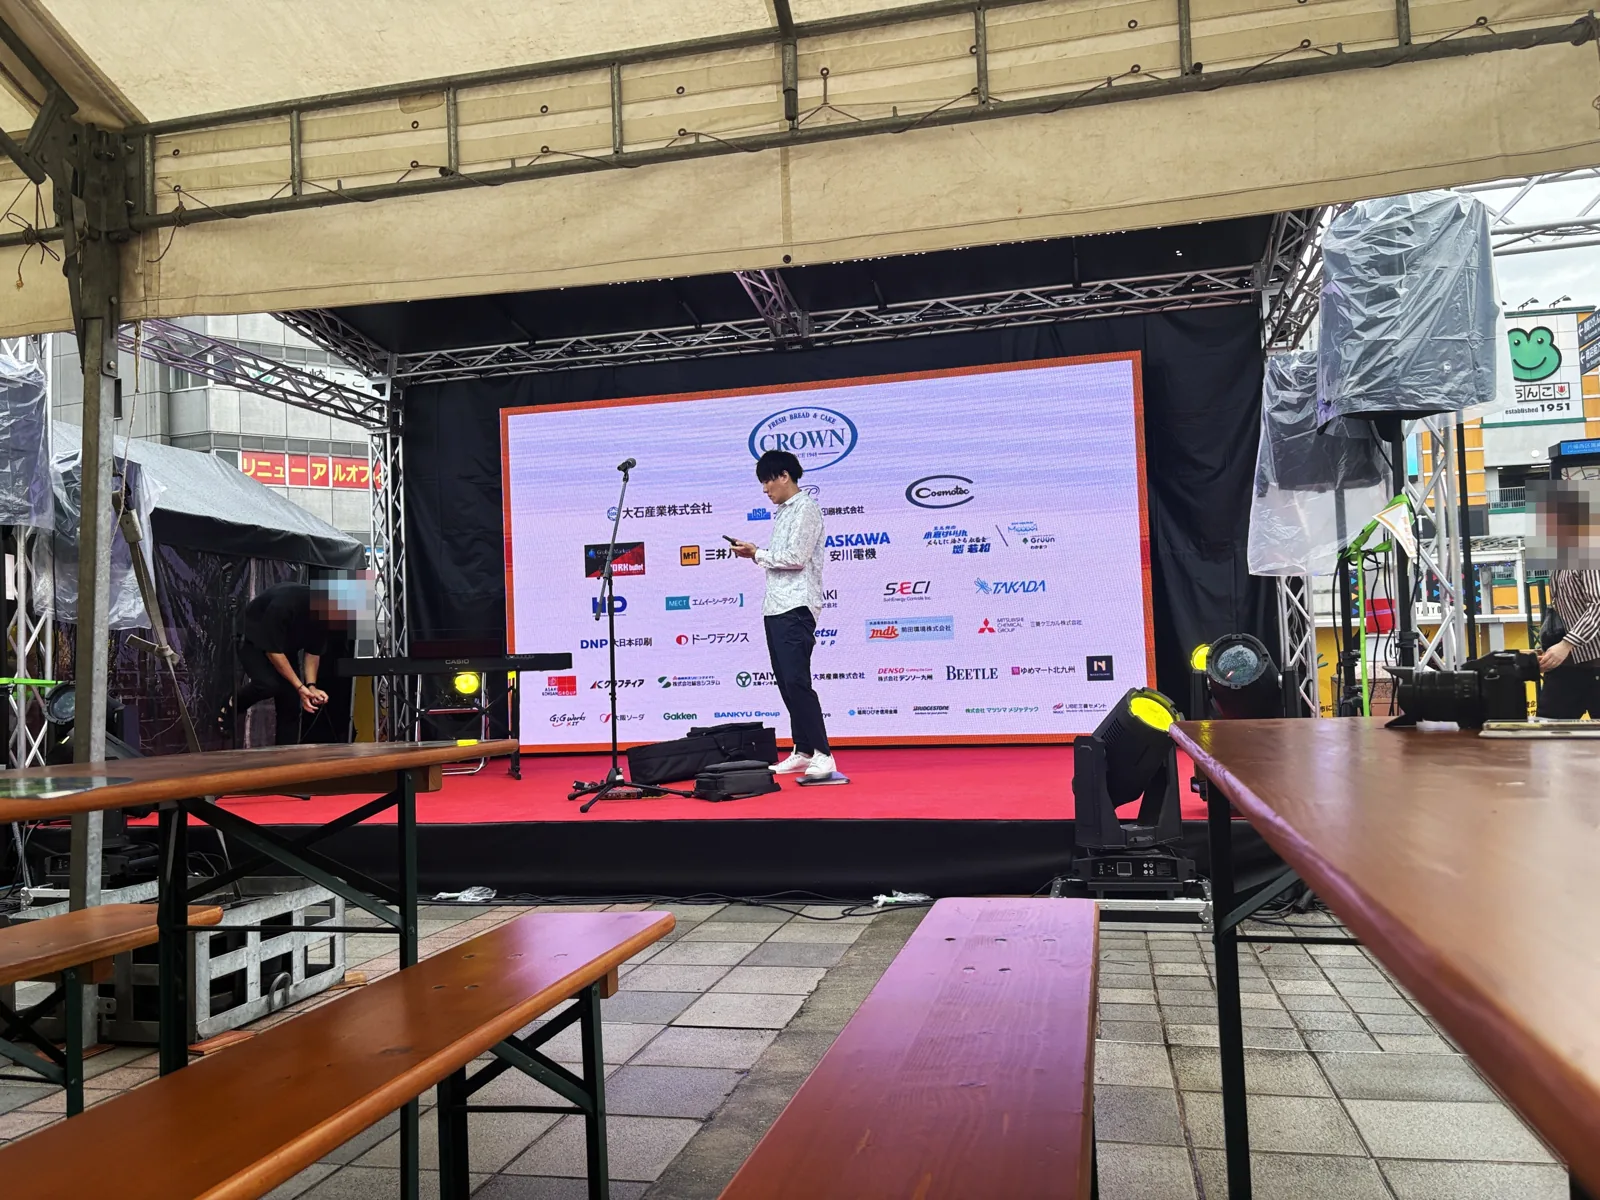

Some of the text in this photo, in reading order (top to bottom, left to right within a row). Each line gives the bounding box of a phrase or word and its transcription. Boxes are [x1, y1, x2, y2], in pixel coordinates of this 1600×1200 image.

[1505, 402, 1571, 415] established 1951
[767, 416, 787, 430] FRESH
[789, 411, 810, 420] BREAD
[820, 413, 837, 425] CAKE
[759, 427, 846, 452] CROWN
[915, 485, 970, 499] Cosmotec
[622, 502, 713, 519] 大石産業株式会社
[821, 506, 865, 516] 印刷株式会社
[824, 532, 891, 548] ASKAWA
[705, 547, 739, 560] 三井ハ
[829, 548, 878, 562] 安川電機
[610, 563, 629, 572] ORK
[883, 580, 931, 596] SECI
[992, 579, 1047, 595] TAKADA
[668, 599, 687, 607] MECT
[692, 632, 750, 645] ドーワテクノス
[814, 628, 838, 638] etsu
[868, 625, 900, 639] mdk
[580, 638, 608, 649] DNP
[751, 671, 775, 681] TAIY
[877, 667, 905, 675] DENSO
[946, 665, 999, 680] BEETLE
[1020, 666, 1076, 675] ゆめマート北九州
[604, 678, 645, 689] クフティア
[899, 674, 933, 682] デンソー九州
[663, 712, 697, 721] Gakken
[714, 710, 781, 719] SANKYU Group
